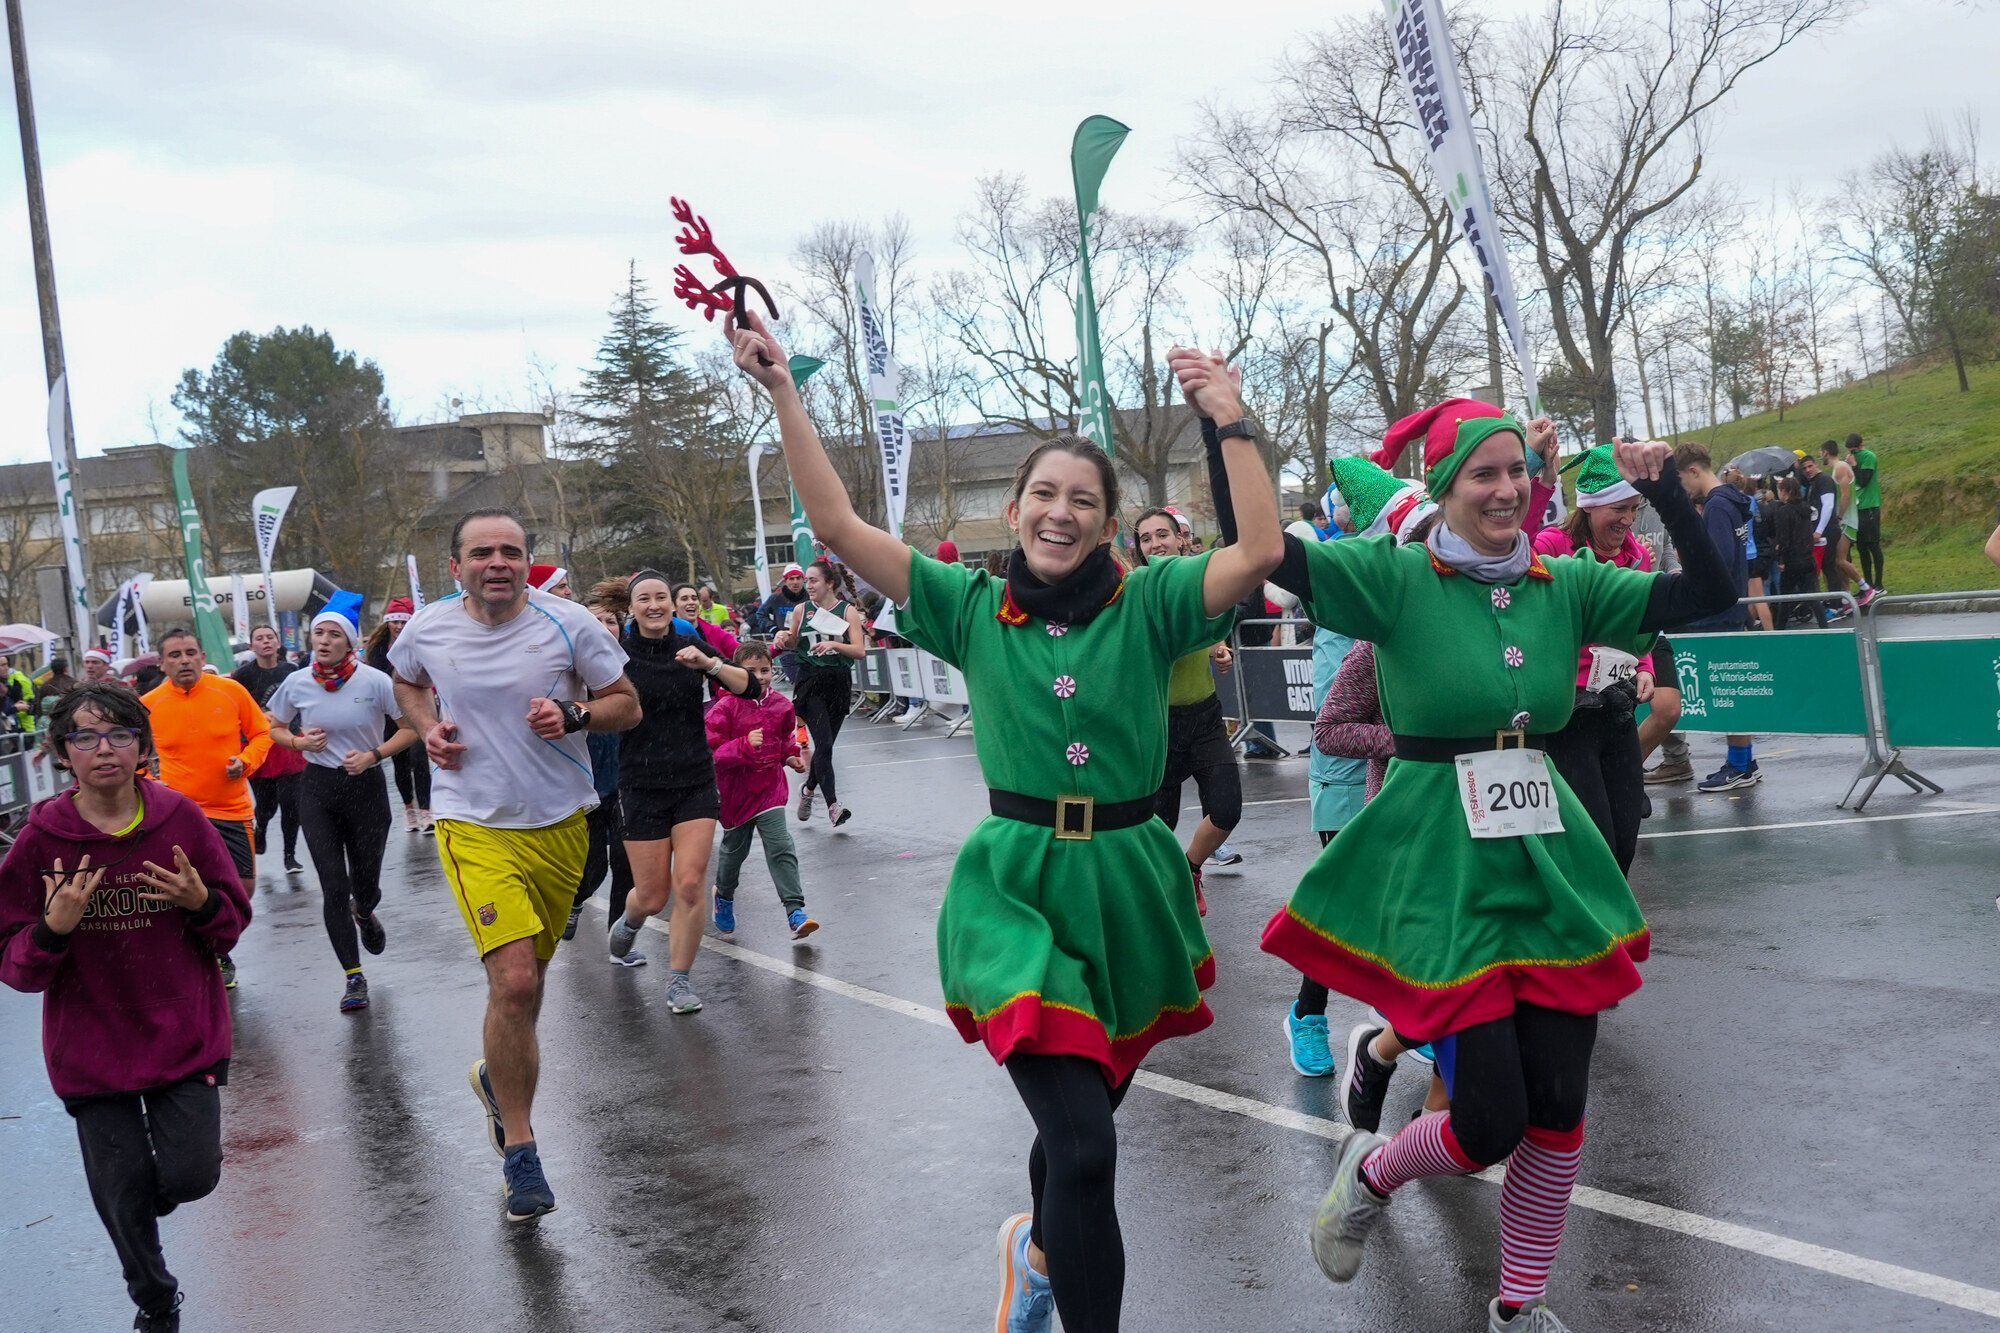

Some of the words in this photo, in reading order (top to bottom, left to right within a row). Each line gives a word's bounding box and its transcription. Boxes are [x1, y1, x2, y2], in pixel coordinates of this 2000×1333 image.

[1707, 661, 1759, 672] Ayuntamiento
[1709, 673, 1718, 682] de
[1720, 672, 1774, 683] Vitoria-Gasteiz
[1711, 686, 1774, 697] Vitoria-Gasteizko
[1713, 698, 1734, 708] Udala
[1488, 780, 1549, 812] 2007
